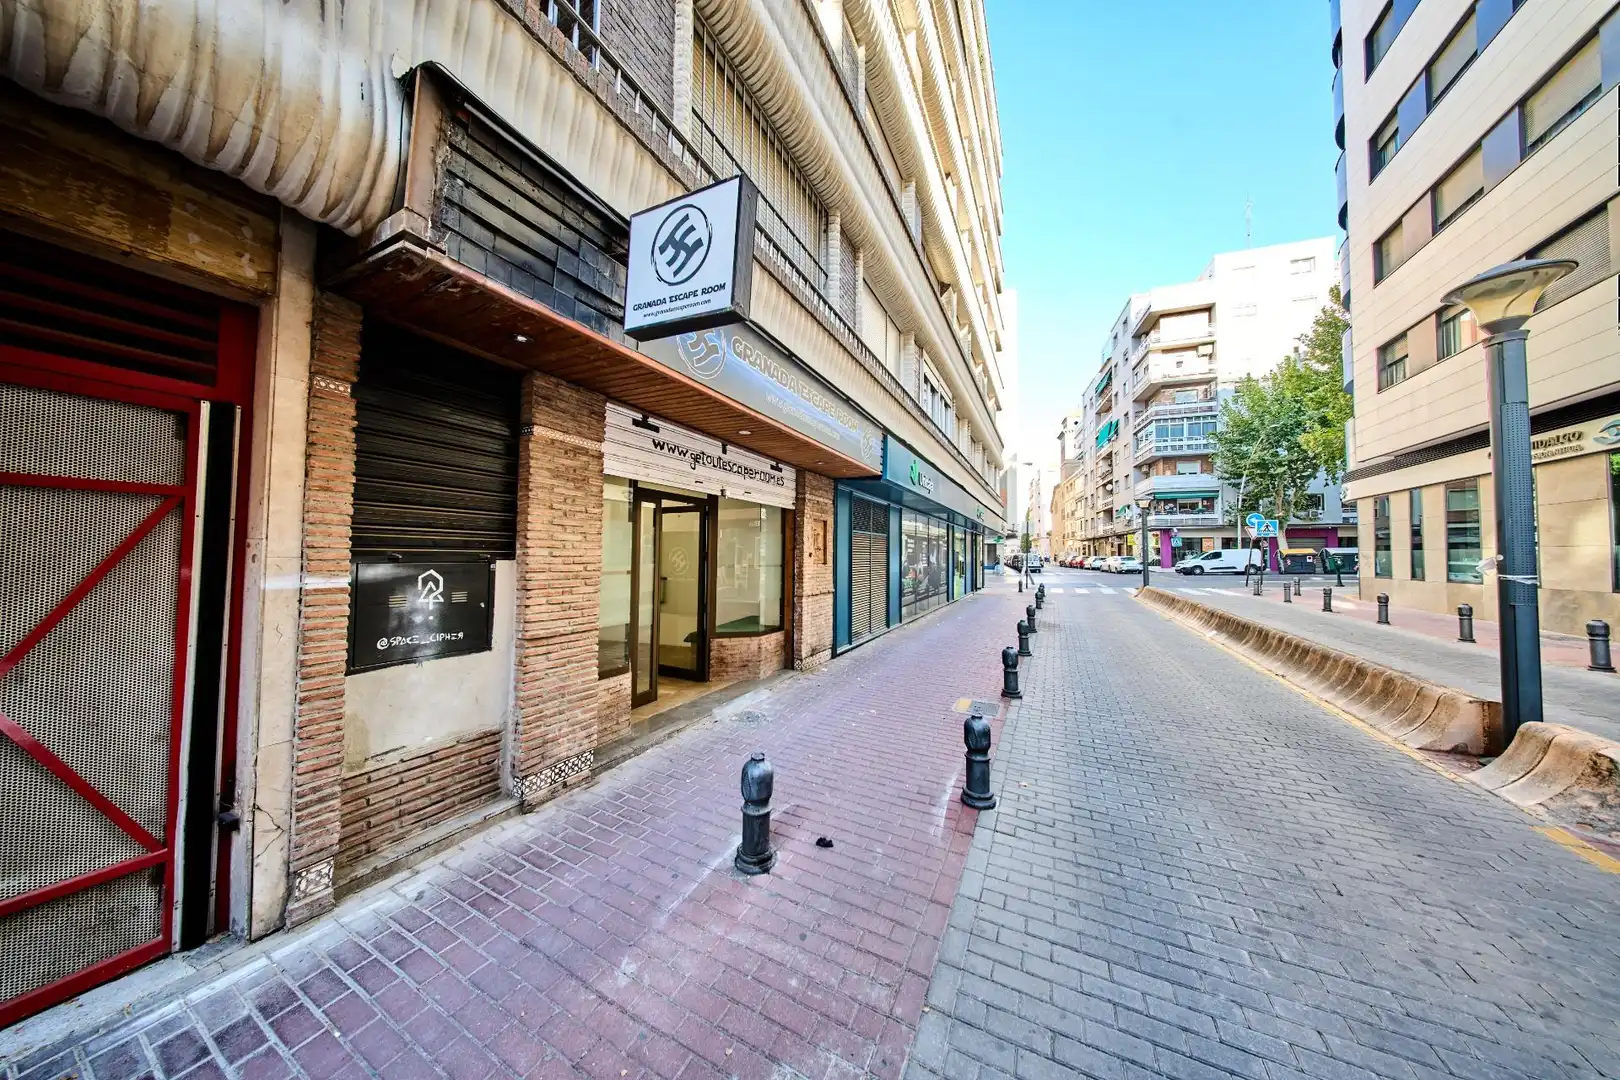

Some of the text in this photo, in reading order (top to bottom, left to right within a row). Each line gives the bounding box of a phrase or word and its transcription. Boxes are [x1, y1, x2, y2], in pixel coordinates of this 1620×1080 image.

[632, 282, 726, 312] GRANADA ESCAPE ROOM
[731, 335, 798, 396] GRANADA
[651, 438, 785, 486] www.getoutescaperoom.es
